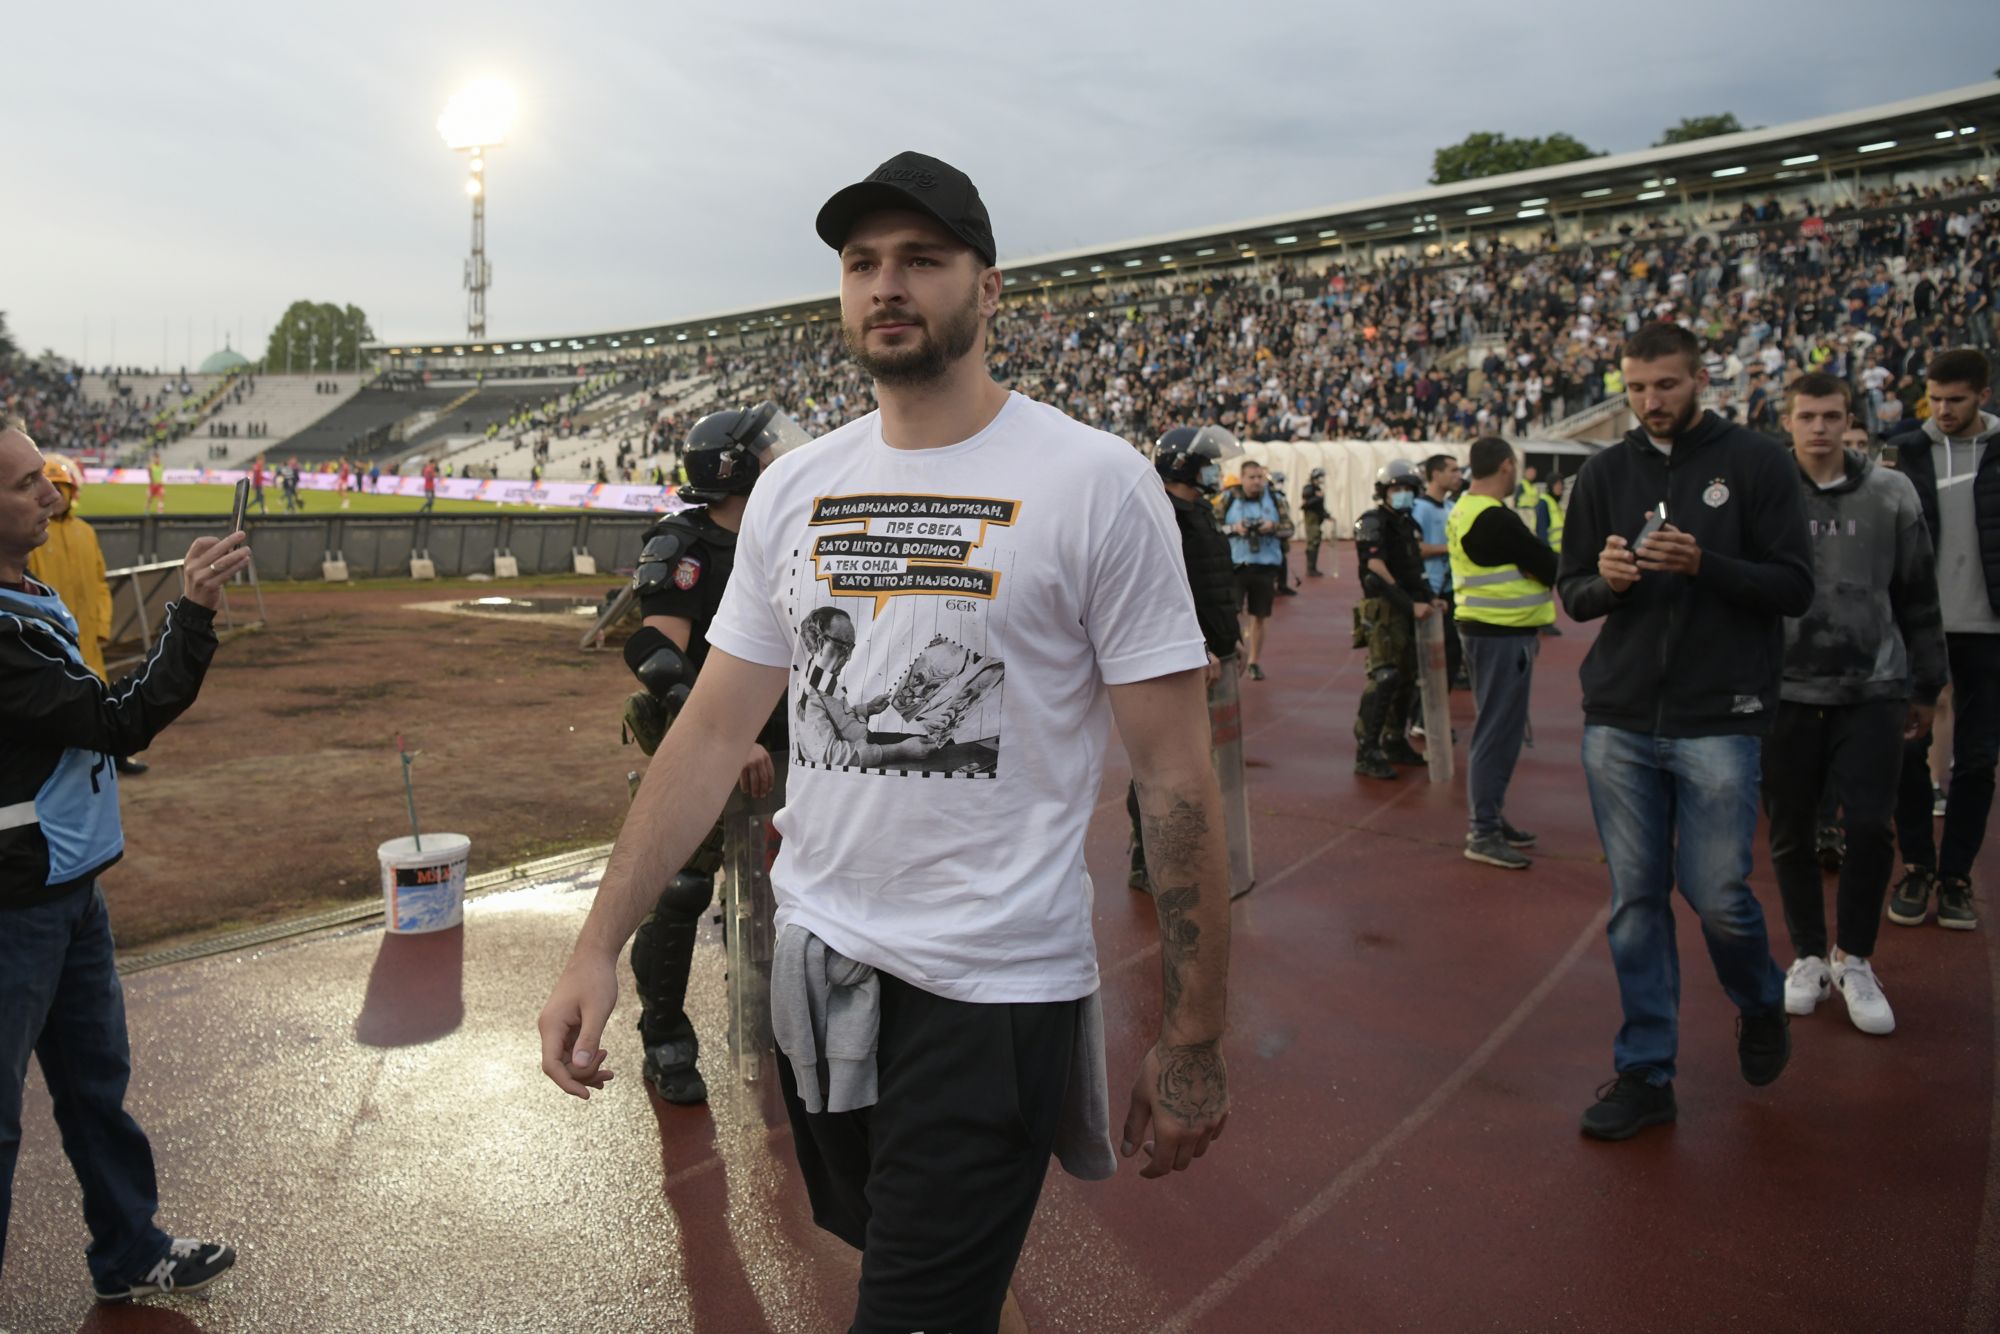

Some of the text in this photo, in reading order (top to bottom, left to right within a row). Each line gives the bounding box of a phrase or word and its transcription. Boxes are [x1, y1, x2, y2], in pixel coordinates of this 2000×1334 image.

[820, 506, 839, 517] МИ
[841, 502, 909, 515] НАВИЈАМО
[911, 502, 928, 513] ЗА
[886, 521, 962, 537] ПРЕ СВЕГА
[818, 540, 849, 553] ЗАТО
[852, 541, 880, 554] ШТО
[884, 542, 899, 555] ГА
[823, 560, 898, 573] А ТЕК ОНДА
[839, 575, 871, 587] ЗАТО
[873, 575, 898, 588] ШТО
[899, 575, 913, 587] ЈЕ
